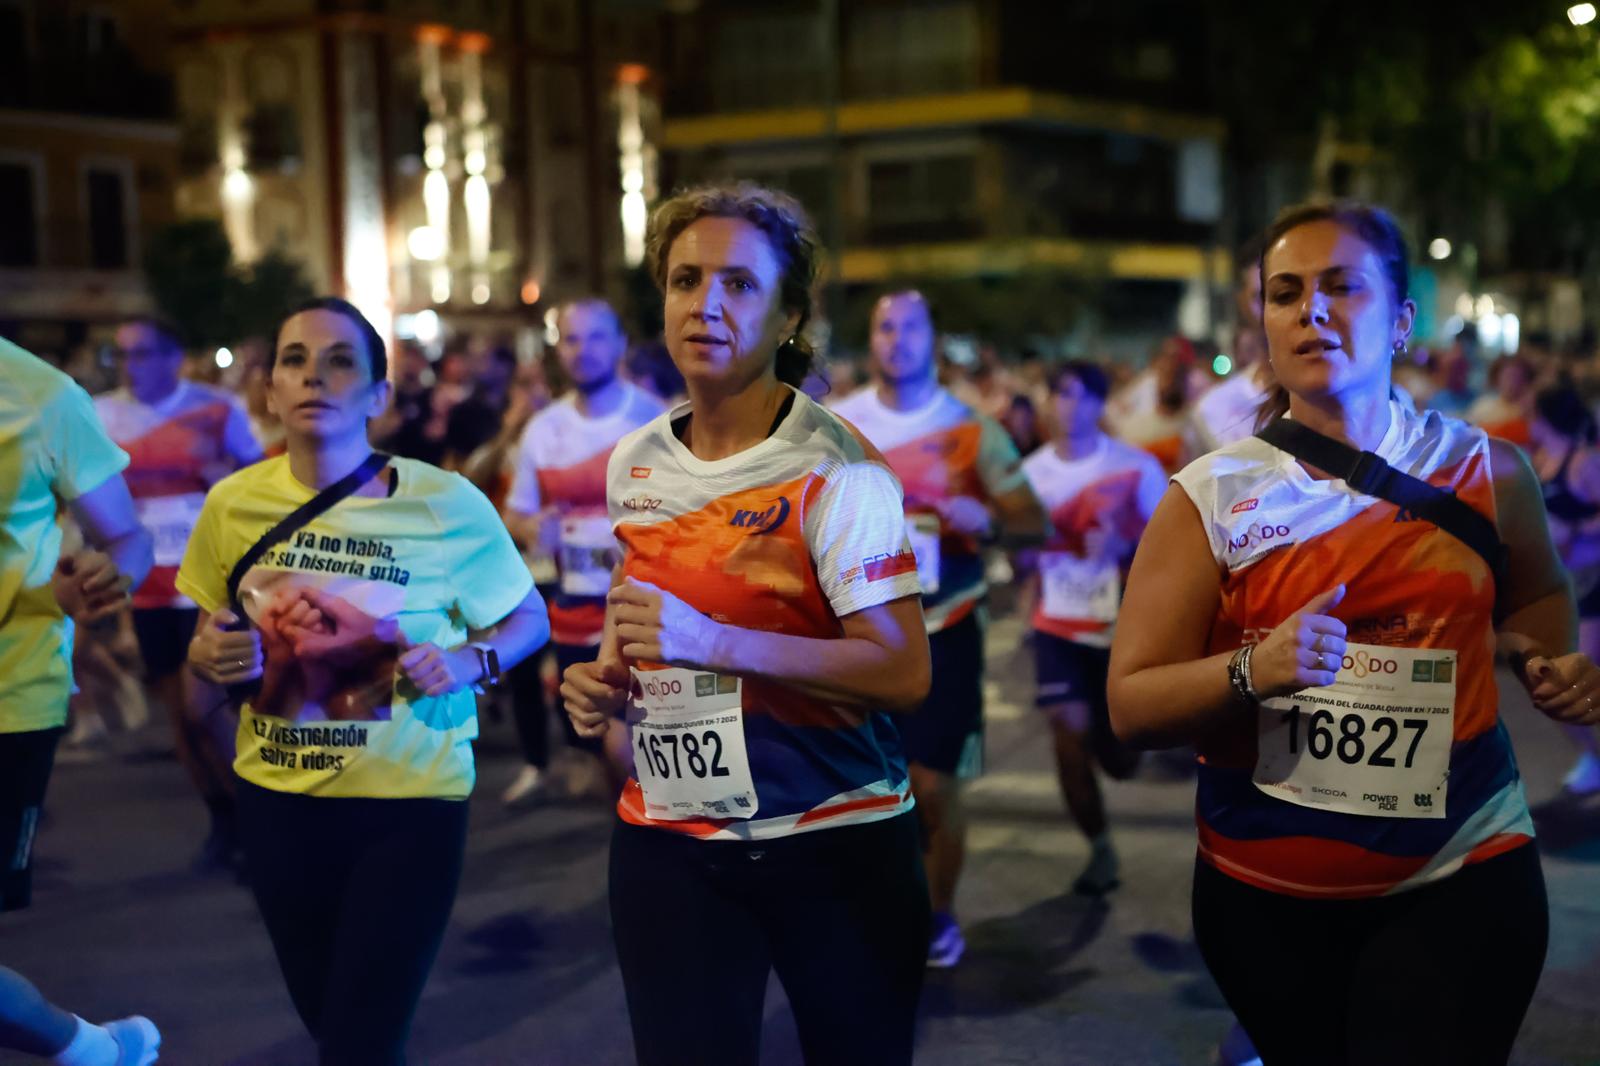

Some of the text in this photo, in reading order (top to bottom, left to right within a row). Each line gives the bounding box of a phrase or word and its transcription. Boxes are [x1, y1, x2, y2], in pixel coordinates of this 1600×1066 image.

[294, 531, 315, 549] ya
[319, 534, 341, 553] no
[346, 537, 396, 563] habla,
[276, 552, 296, 567] su
[299, 553, 364, 577] historia
[369, 565, 411, 586] grita
[1293, 694, 1335, 705] NOCTURNA
[1336, 700, 1351, 708] DEL
[1352, 702, 1413, 713] GUADALQUIVIR
[721, 715, 738, 724] 2025
[1281, 705, 1428, 768] 16827
[260, 746, 345, 771] salva vidas
[638, 730, 730, 779] 16782
[1363, 793, 1398, 803] POWER
